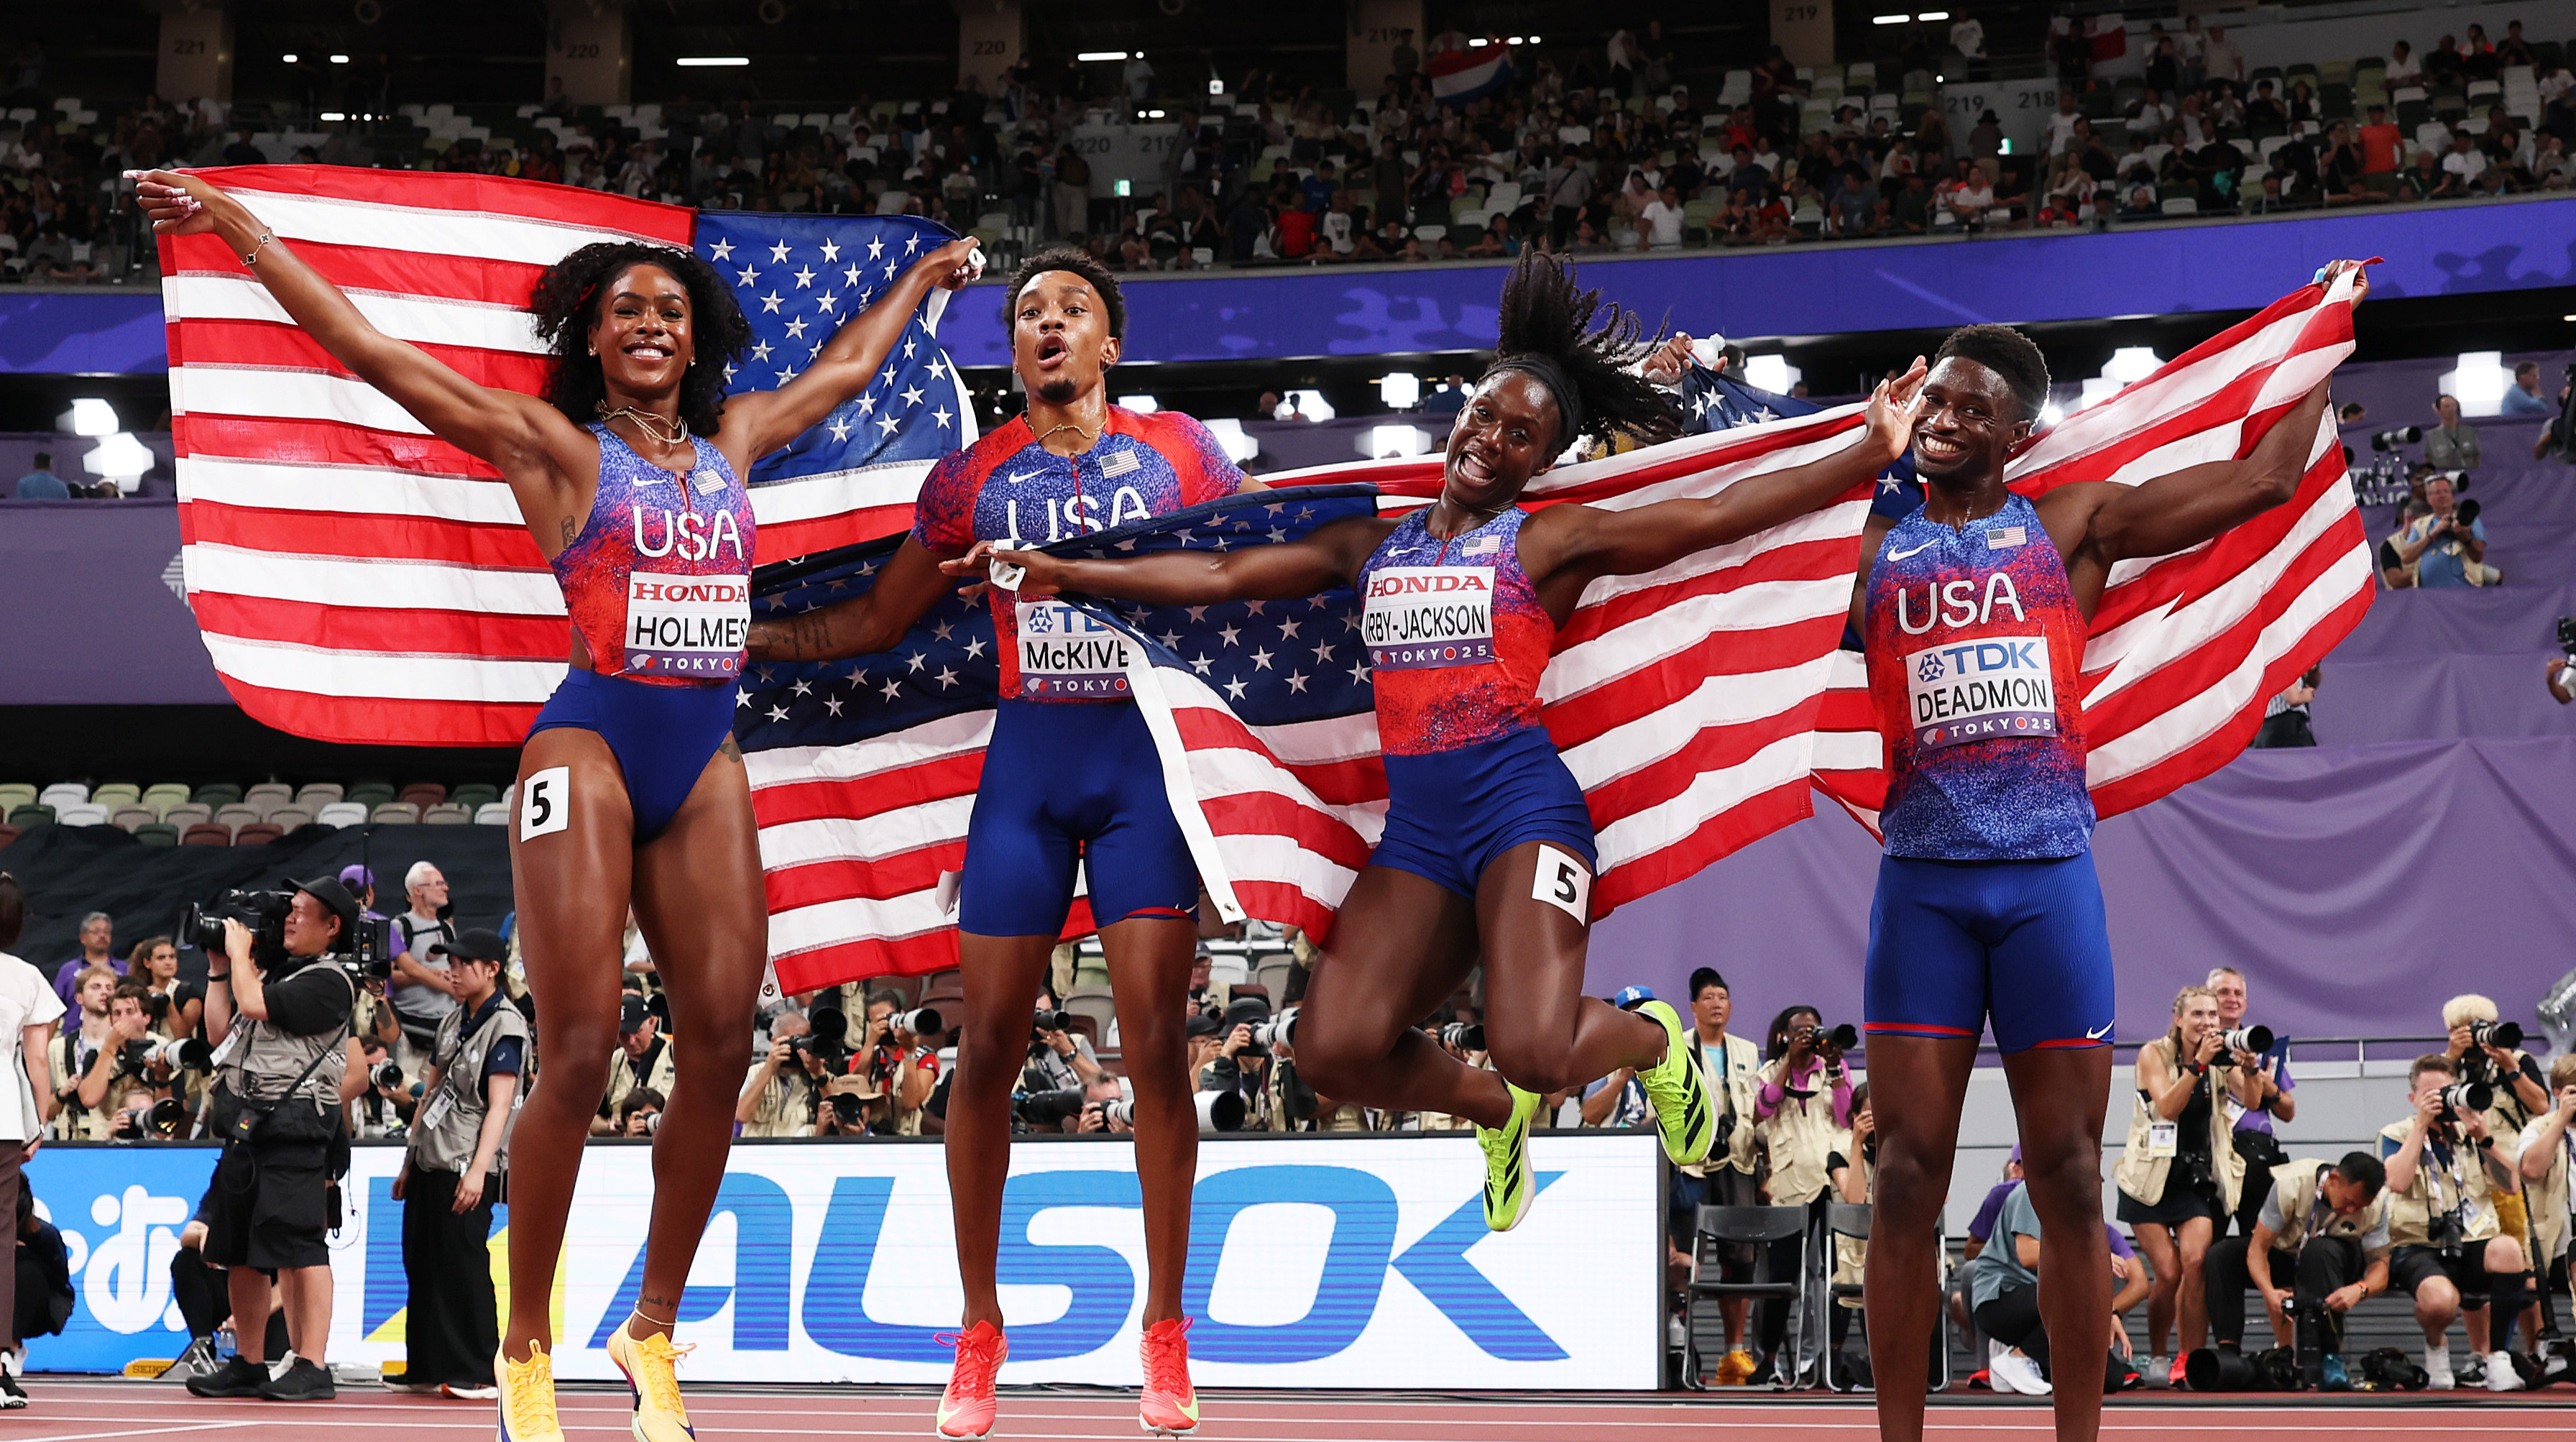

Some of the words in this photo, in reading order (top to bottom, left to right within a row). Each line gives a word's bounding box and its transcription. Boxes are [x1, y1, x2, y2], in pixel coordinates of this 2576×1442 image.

[1785, 6, 1817, 21] 219
[174, 40, 204, 54] 221
[568, 44, 599, 58] 220
[974, 41, 1006, 55] 220
[1947, 96, 1984, 113] 219
[2018, 91, 2056, 109] 218
[1076, 137, 1110, 154] 220
[1008, 486, 1151, 542] USA
[632, 505, 743, 561] USA
[632, 582, 748, 602] HONDA
[1368, 576, 1489, 598] HONDA
[1898, 572, 2025, 635] USA
[635, 616, 747, 647] HOLMES
[1366, 605, 1486, 642] IRBY-JACKSON
[1943, 642, 2040, 674] TDK
[1053, 678, 1128, 692] TOKYO
[1918, 678, 2048, 722] DEADMON
[532, 781, 551, 827] 5
[1555, 862, 1577, 903] 5
[587, 1165, 1570, 1364] ALSOK
